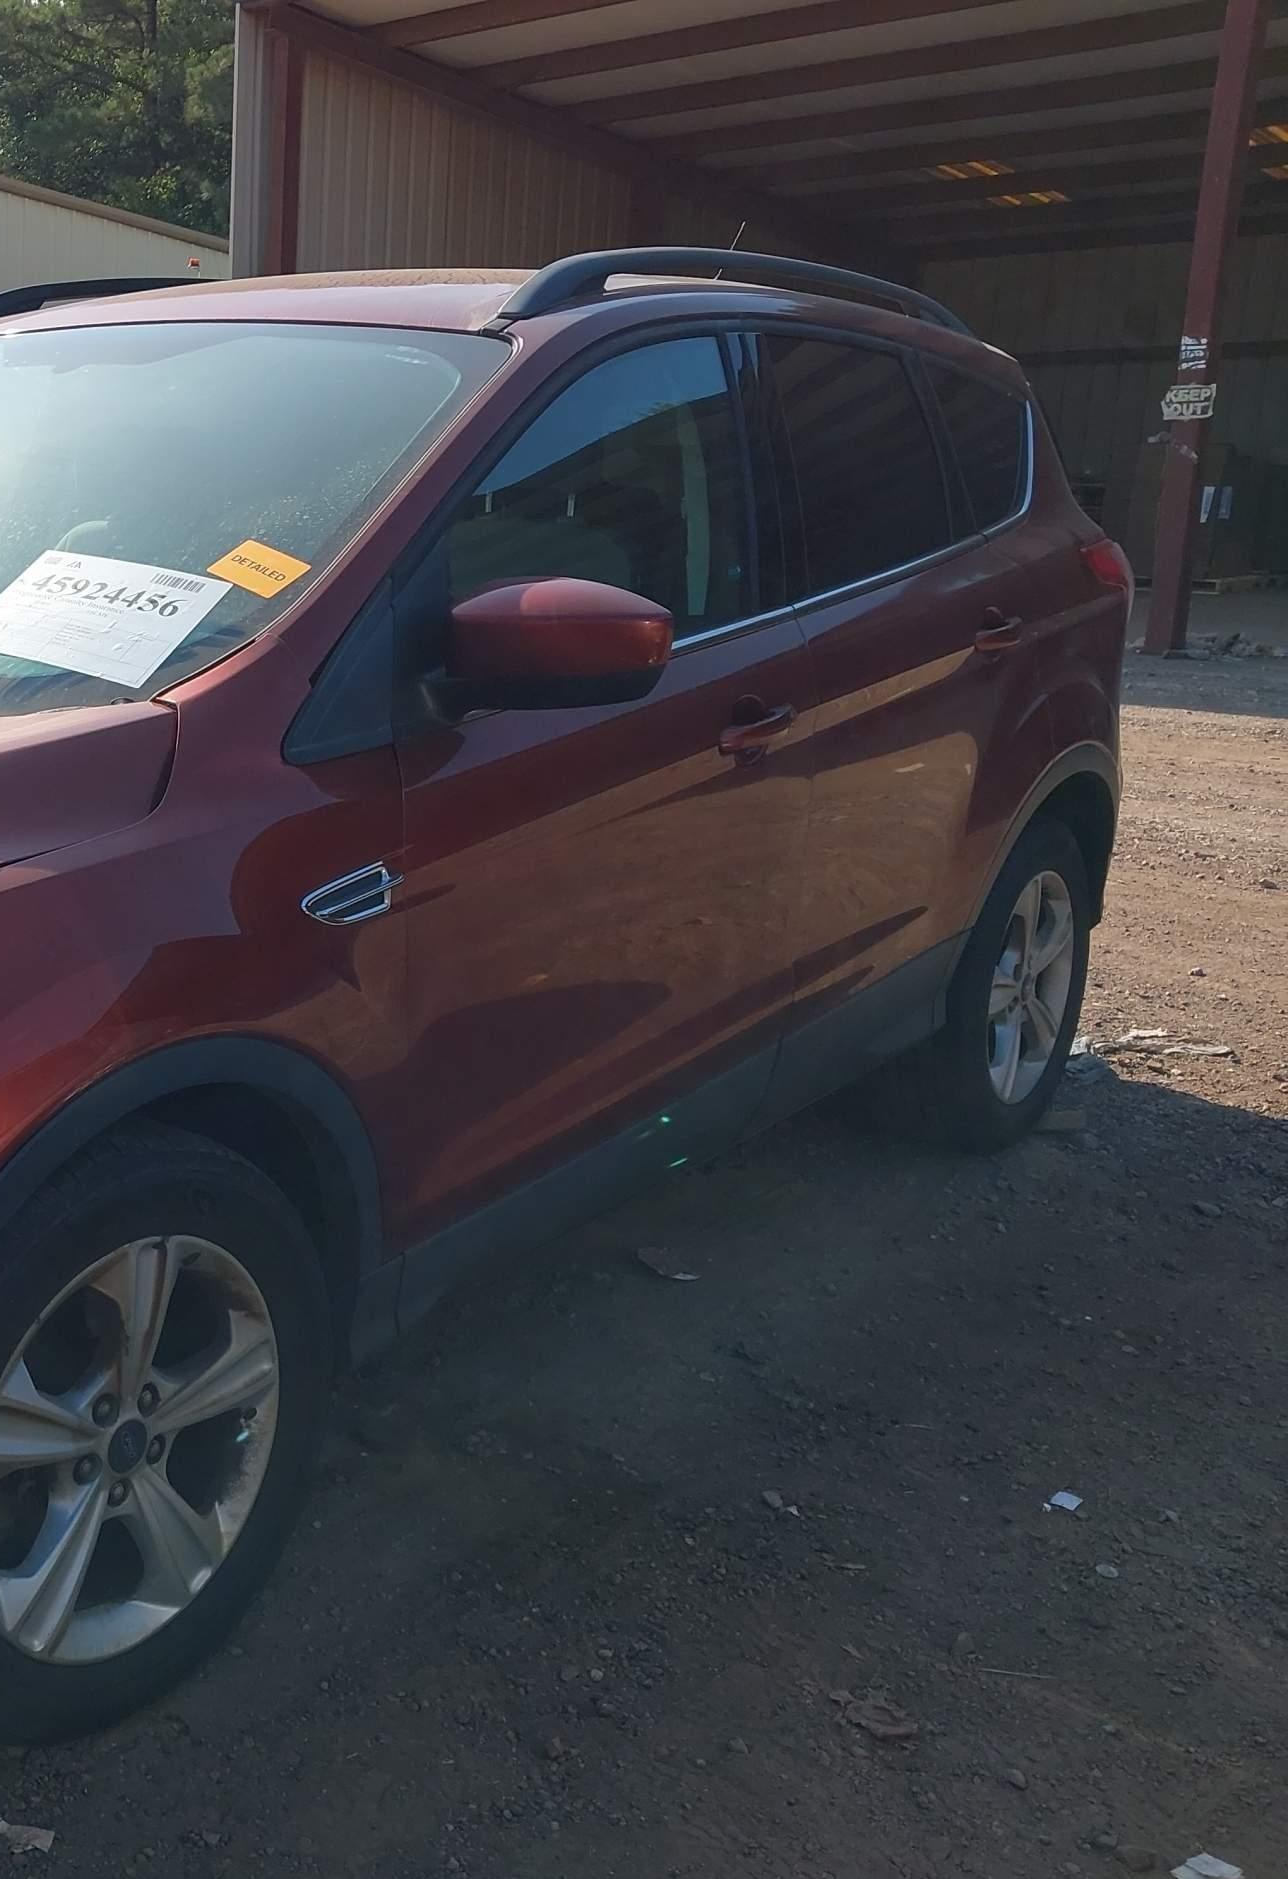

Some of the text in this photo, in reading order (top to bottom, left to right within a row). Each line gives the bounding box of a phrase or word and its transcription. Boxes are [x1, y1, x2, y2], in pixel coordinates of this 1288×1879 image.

[1166, 389, 1210, 402] KEEP
[1171, 402, 1206, 416] OUT
[231, 553, 286, 583] DETAILED
[32, 574, 188, 617] 45924456
